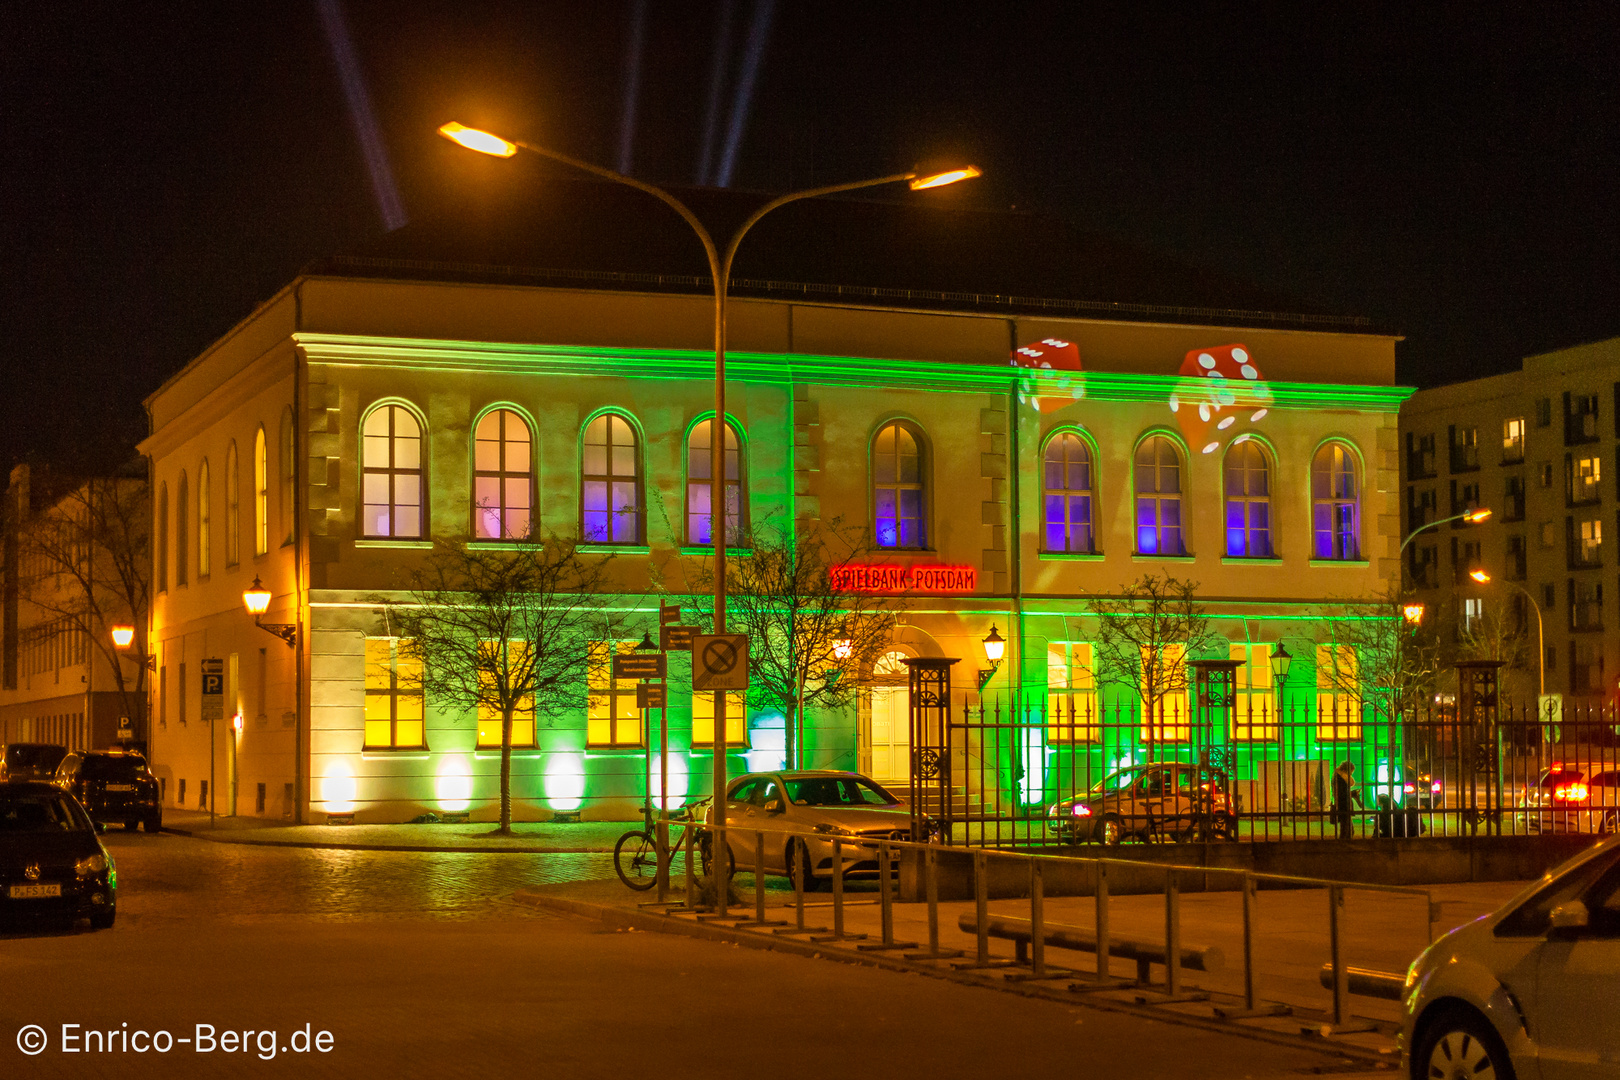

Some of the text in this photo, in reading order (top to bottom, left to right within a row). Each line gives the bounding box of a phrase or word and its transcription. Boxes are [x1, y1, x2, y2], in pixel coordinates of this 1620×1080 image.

[835, 569, 974, 589] SPIELBANK POTSDAM
[206, 676, 219, 693] P
[120, 717, 129, 728] P
[41, 886, 57, 895] 142
